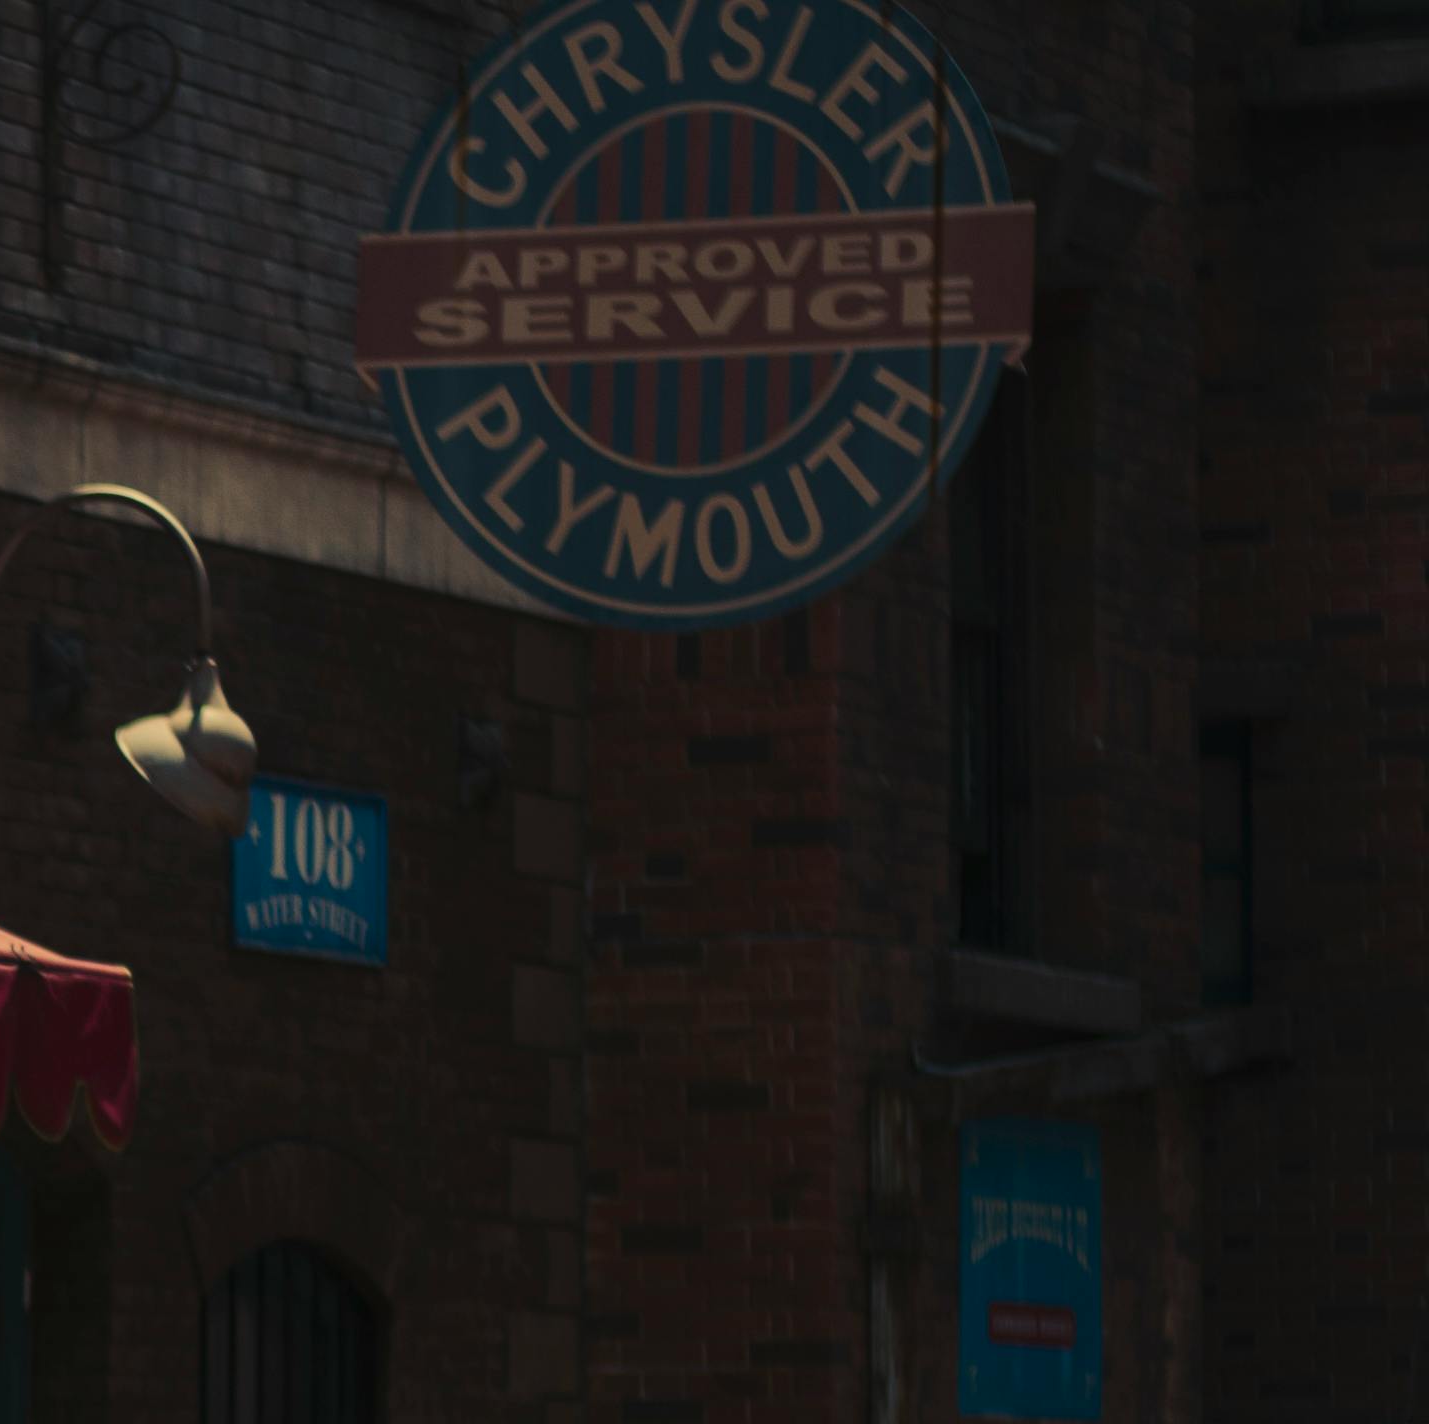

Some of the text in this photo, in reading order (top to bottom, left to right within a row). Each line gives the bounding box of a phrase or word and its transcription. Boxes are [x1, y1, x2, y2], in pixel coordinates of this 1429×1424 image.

[446, 0, 949, 209] CHRYSLER
[454, 228, 936, 293] APPROVED
[413, 275, 975, 348] SERVICE
[435, 364, 947, 589] PLYMOUTH
[269, 792, 355, 893] 108
